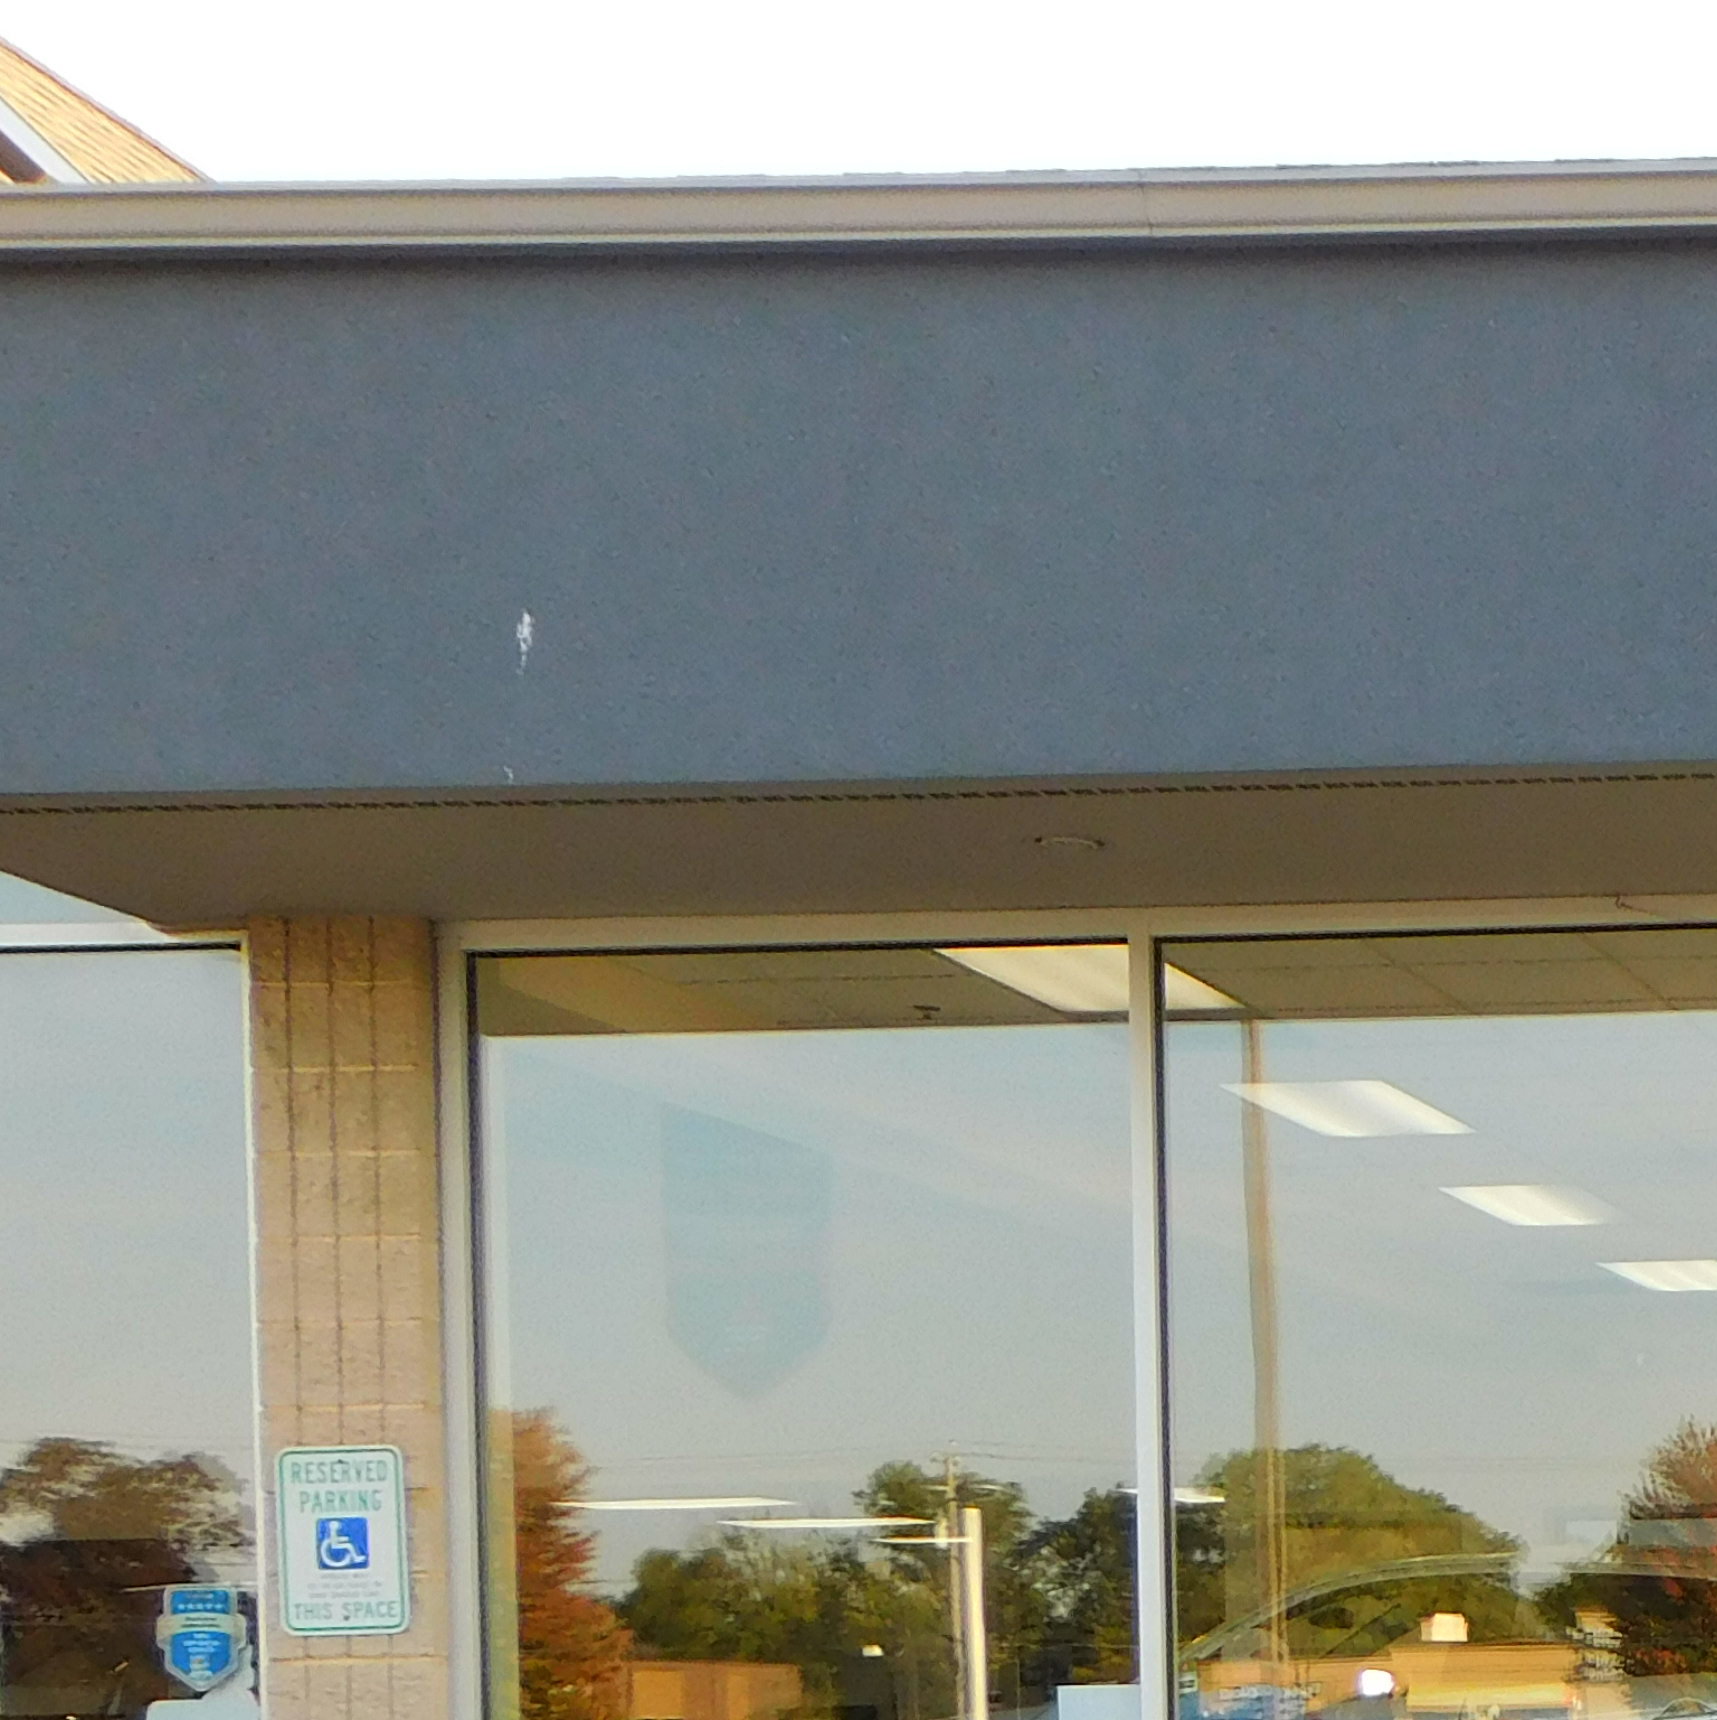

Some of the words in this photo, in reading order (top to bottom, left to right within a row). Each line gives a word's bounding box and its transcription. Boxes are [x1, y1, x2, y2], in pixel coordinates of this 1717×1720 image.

[290, 1459, 388, 1484] RESERVED
[299, 1488, 383, 1513] PARKING
[294, 1602, 333, 1620] THIS
[343, 1600, 398, 1620] SPACE
